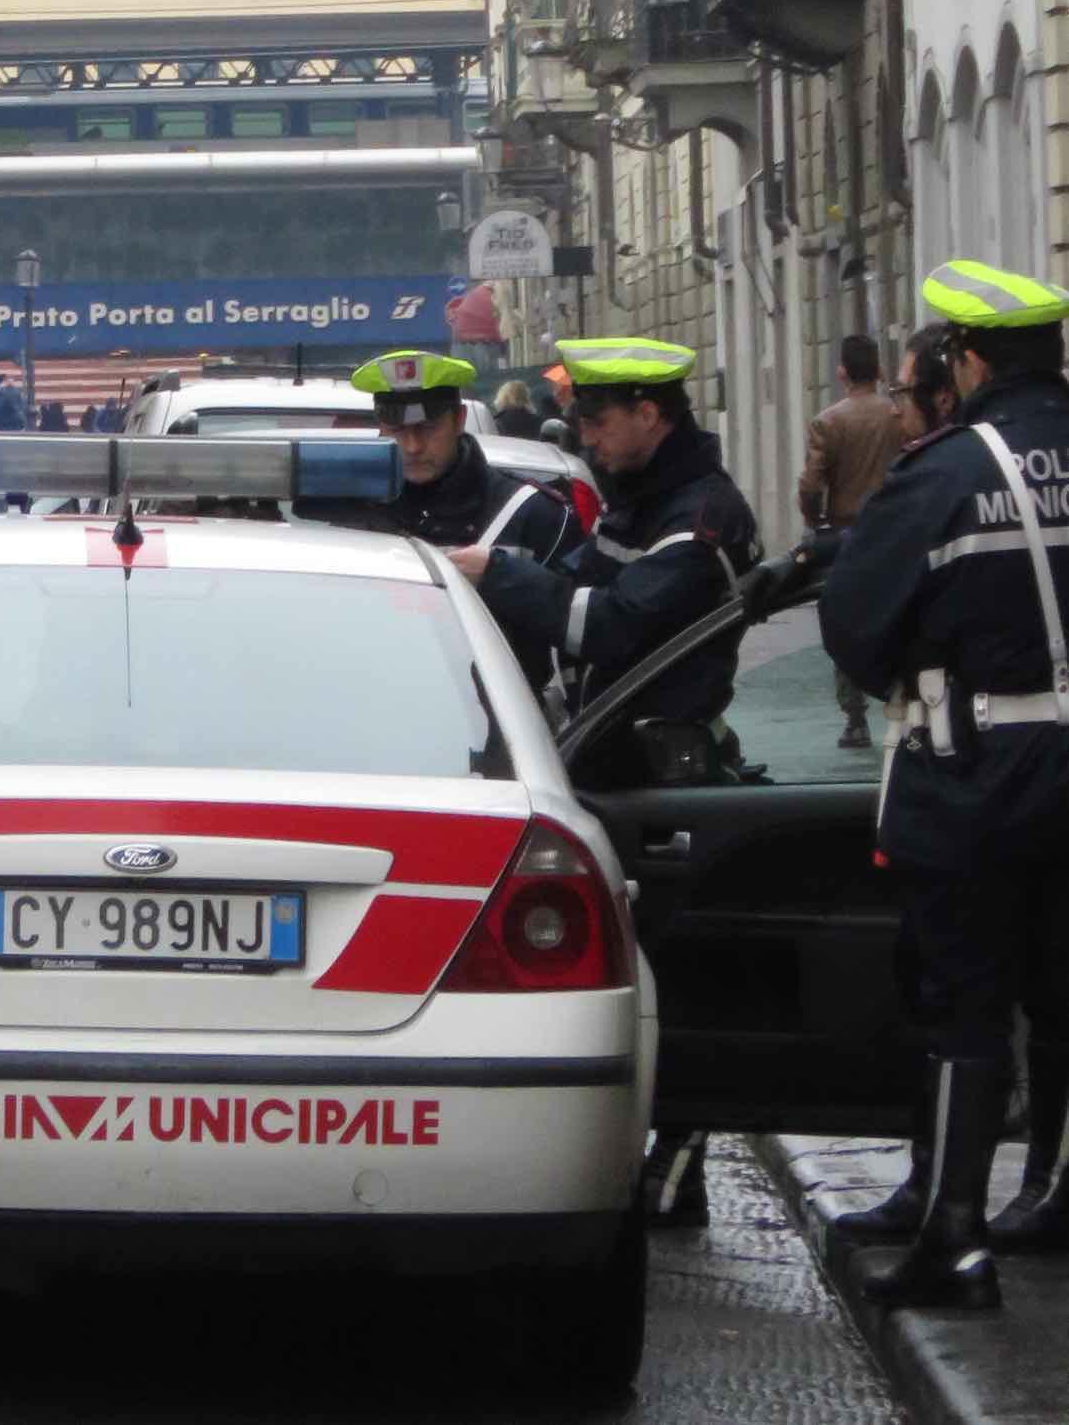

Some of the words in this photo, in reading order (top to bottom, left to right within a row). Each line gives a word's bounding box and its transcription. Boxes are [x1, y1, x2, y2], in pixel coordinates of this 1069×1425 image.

[89, 302, 174, 326] Porta
[185, 299, 213, 325] al
[224, 296, 371, 328] Serraglio
[120, 846, 161, 867] Ford
[11, 895, 75, 949] CY
[98, 897, 264, 953] 989NJ
